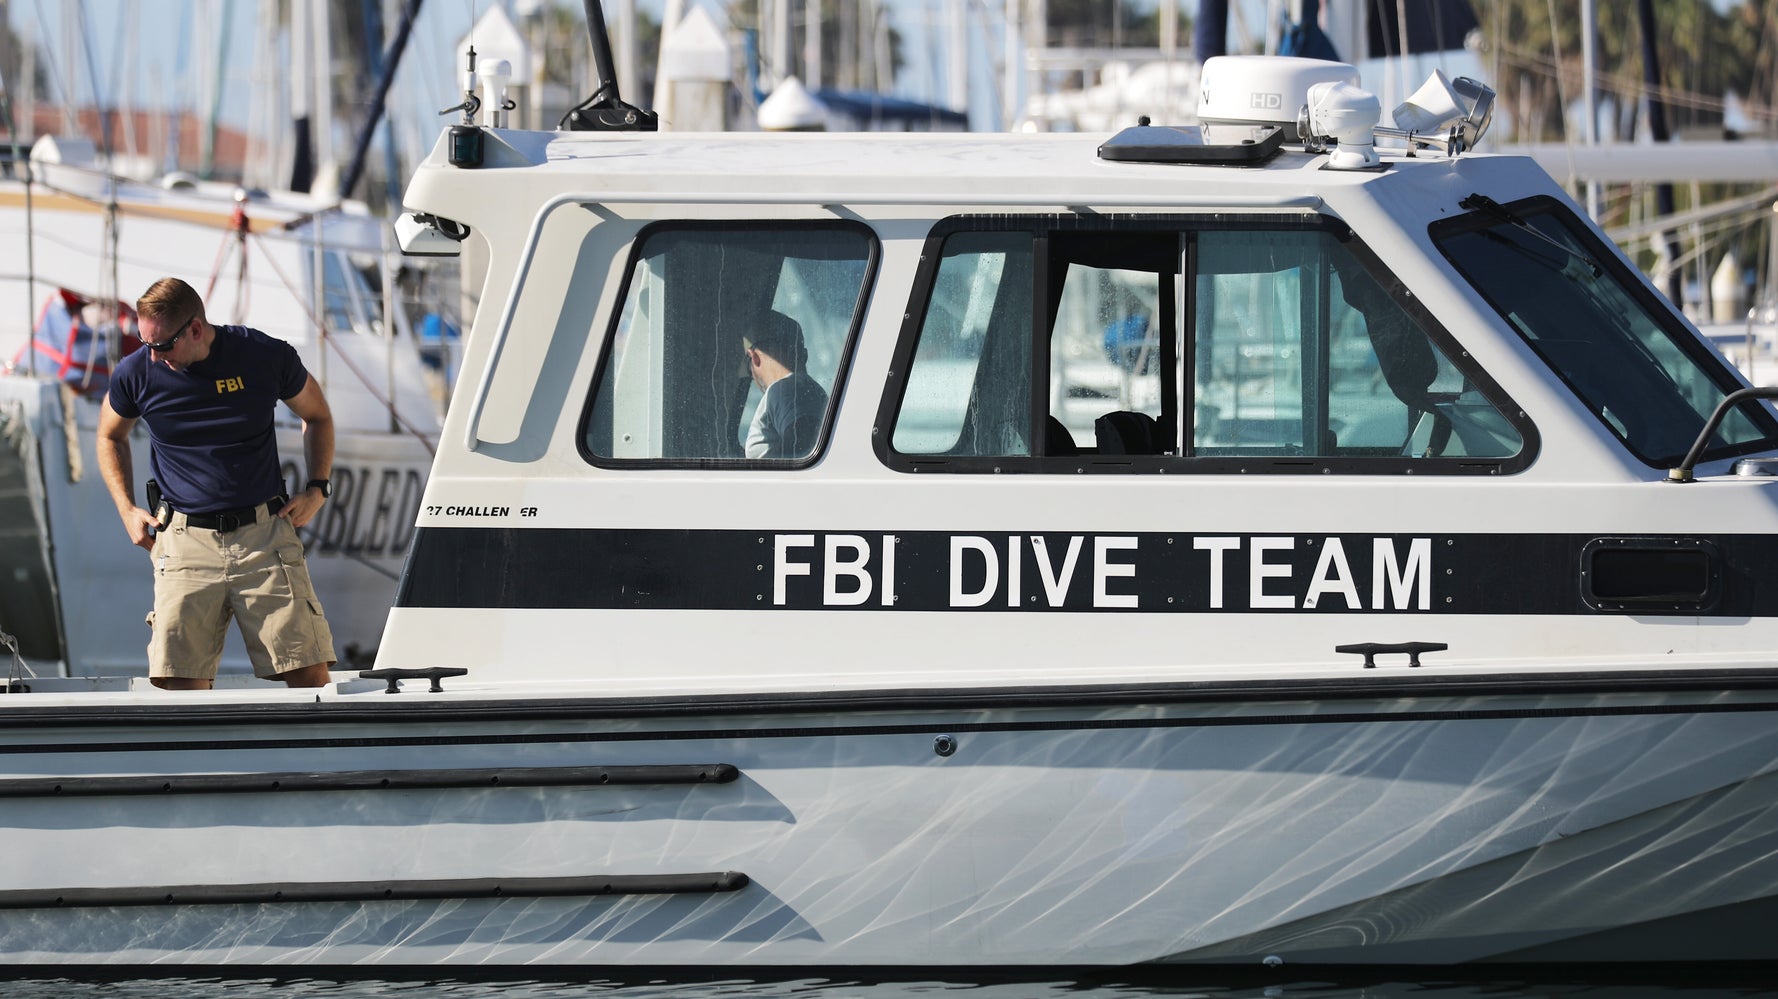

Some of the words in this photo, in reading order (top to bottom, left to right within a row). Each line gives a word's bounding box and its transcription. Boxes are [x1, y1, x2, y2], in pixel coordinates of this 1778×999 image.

[1251, 93, 1281, 109] HD
[215, 376, 245, 394] FBI
[773, 534, 895, 606] FBI
[949, 535, 1139, 608] DIVE
[1193, 536, 1432, 609] TEAM
